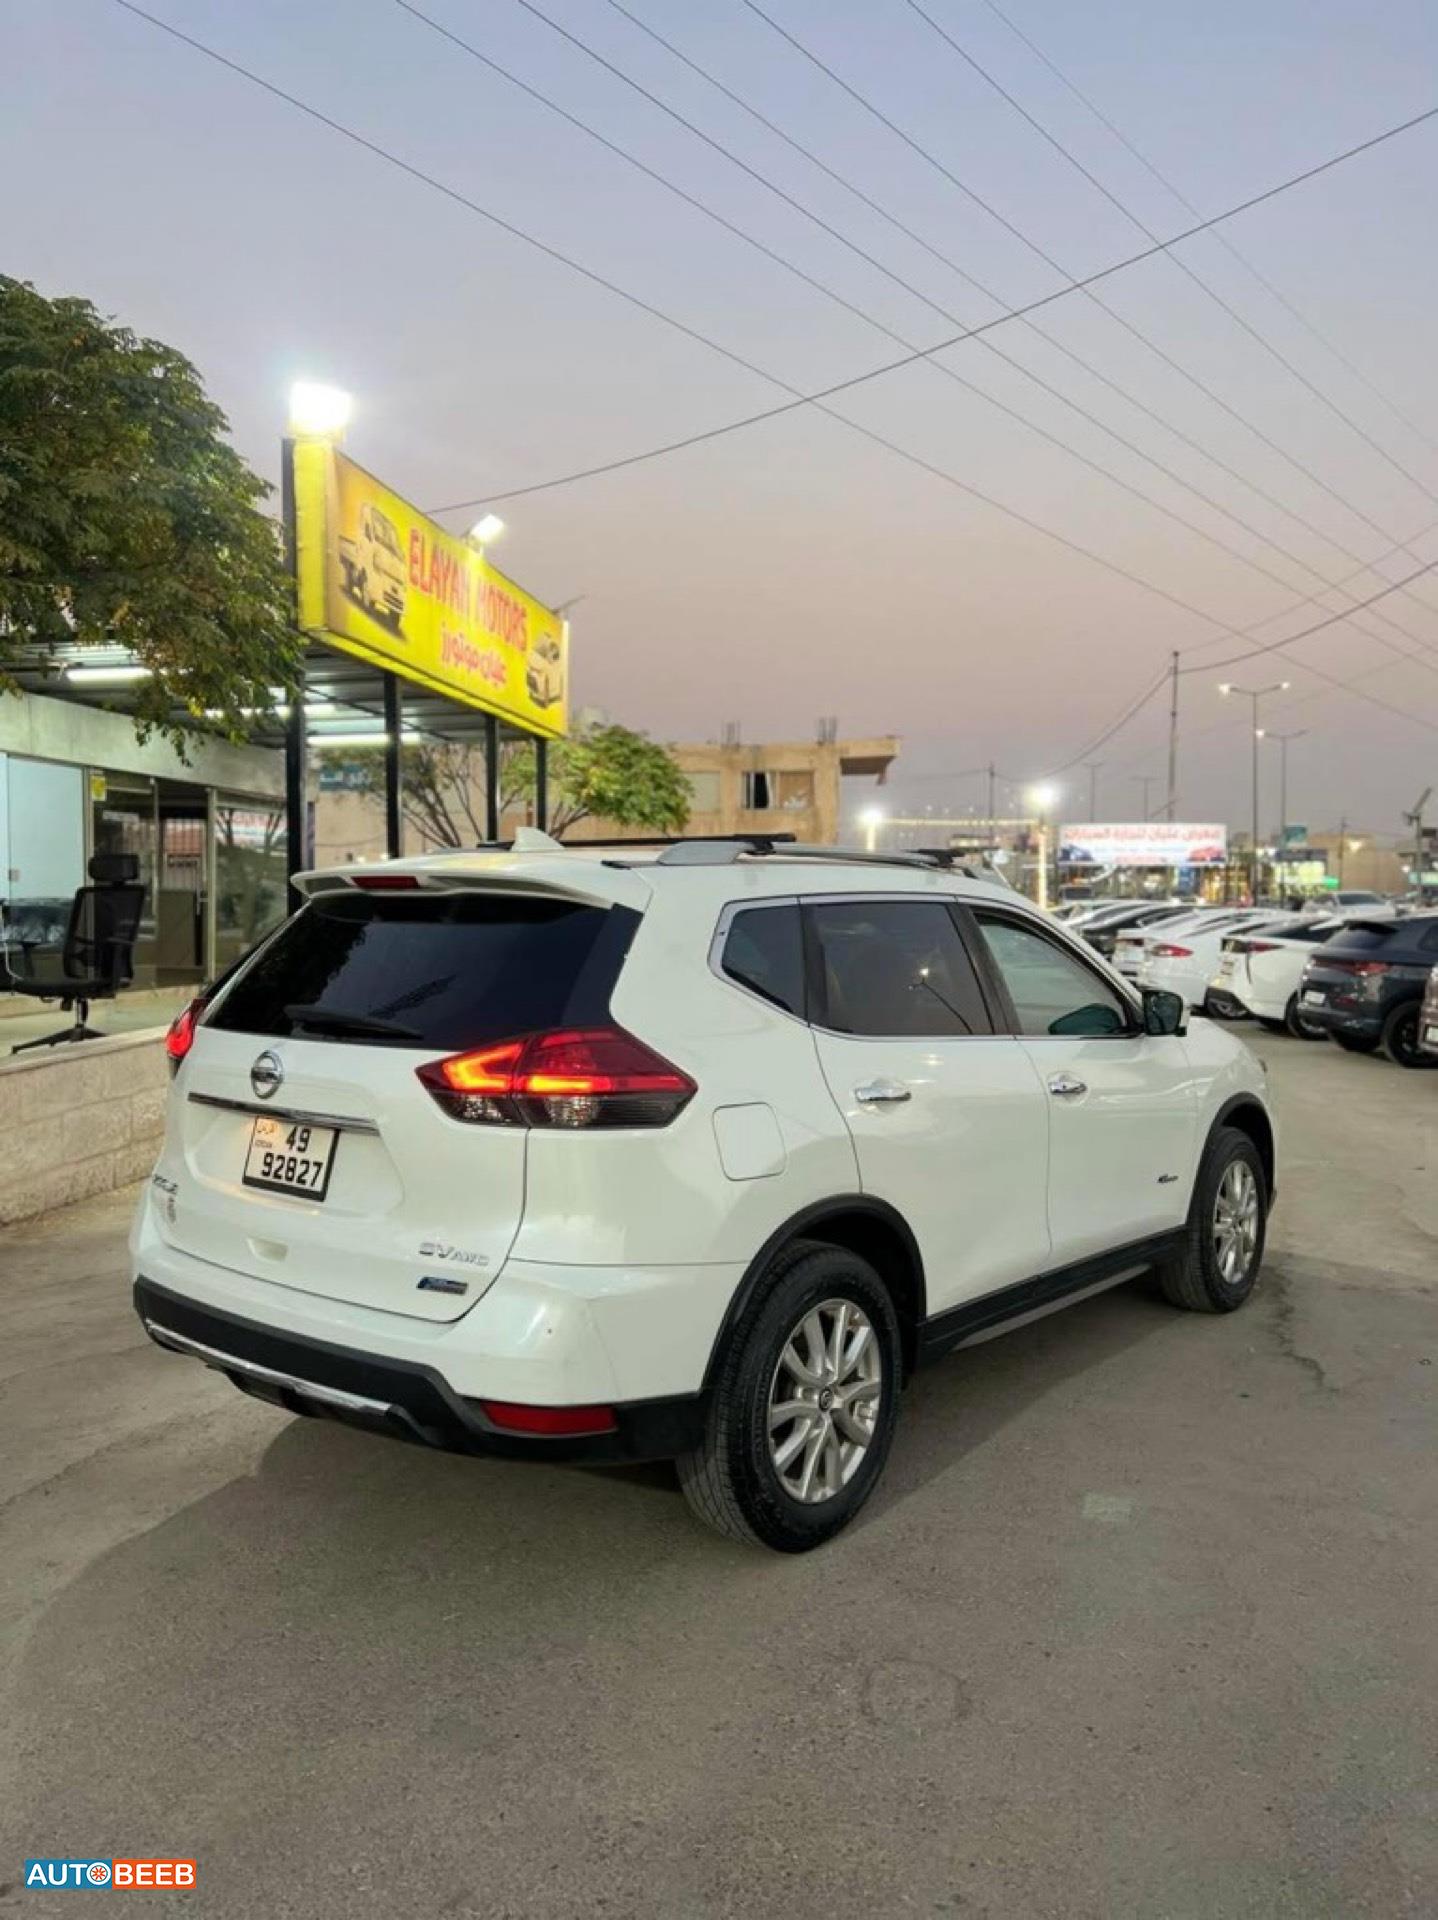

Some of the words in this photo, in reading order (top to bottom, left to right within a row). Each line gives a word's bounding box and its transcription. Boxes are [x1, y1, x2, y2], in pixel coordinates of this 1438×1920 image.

[409, 527, 470, 617] ELAYAN
[286, 1126, 311, 1153] 49
[261, 1152, 323, 1188] 92827
